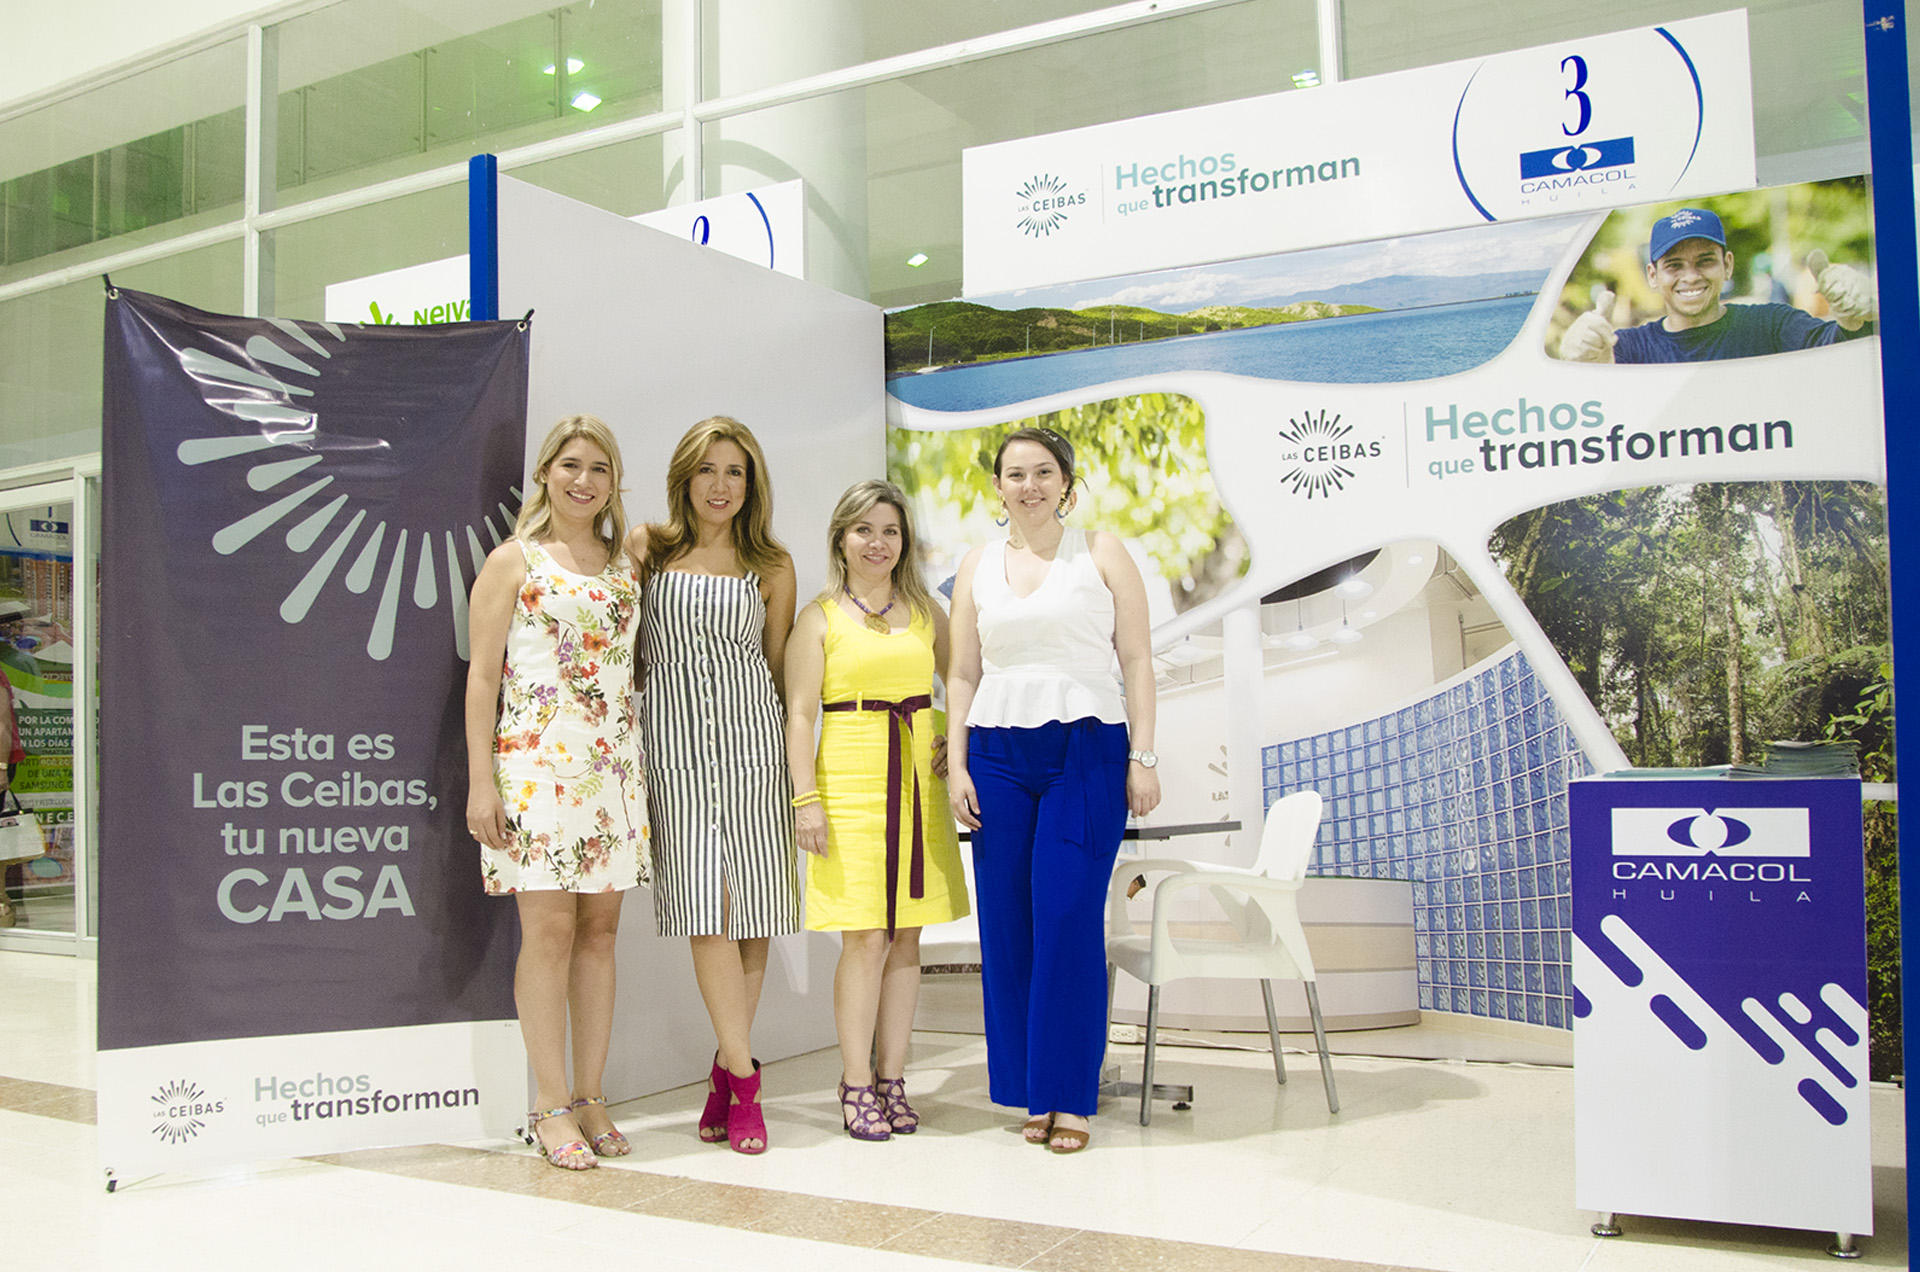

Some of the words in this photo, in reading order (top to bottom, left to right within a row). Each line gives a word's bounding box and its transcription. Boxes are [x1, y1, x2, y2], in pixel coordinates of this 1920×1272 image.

[1560, 55, 1592, 136] 3
[1115, 152, 1236, 190] Hechos
[1117, 199, 1149, 216] que
[1152, 157, 1361, 208] transforman
[1521, 169, 1637, 194] CAMACOL
[1033, 192, 1086, 212] CEIBAS
[1521, 183, 1637, 204] HUILA
[1425, 397, 1604, 442] Hechos
[1282, 452, 1298, 461] LAS
[1303, 441, 1381, 462] CEIBAS
[1428, 456, 1475, 481] que
[1480, 420, 1794, 472] transforman
[19, 716, 38, 725] POR
[40, 716, 51, 725] LA
[29, 740, 46, 748] LOS
[242, 725, 334, 761] Esta
[347, 733, 396, 761] es
[193, 772, 269, 808] Las
[280, 771, 438, 811] Ceibas,
[220, 822, 265, 856] tu
[279, 825, 409, 854] nueva
[1612, 862, 1811, 882] CAMACOL
[217, 864, 416, 924] CASA
[1613, 889, 1811, 902] HUILA
[254, 1072, 371, 1102] Hechos
[169, 1101, 224, 1118] CEIBAS
[256, 1110, 287, 1127] que
[291, 1088, 480, 1121] transforman
